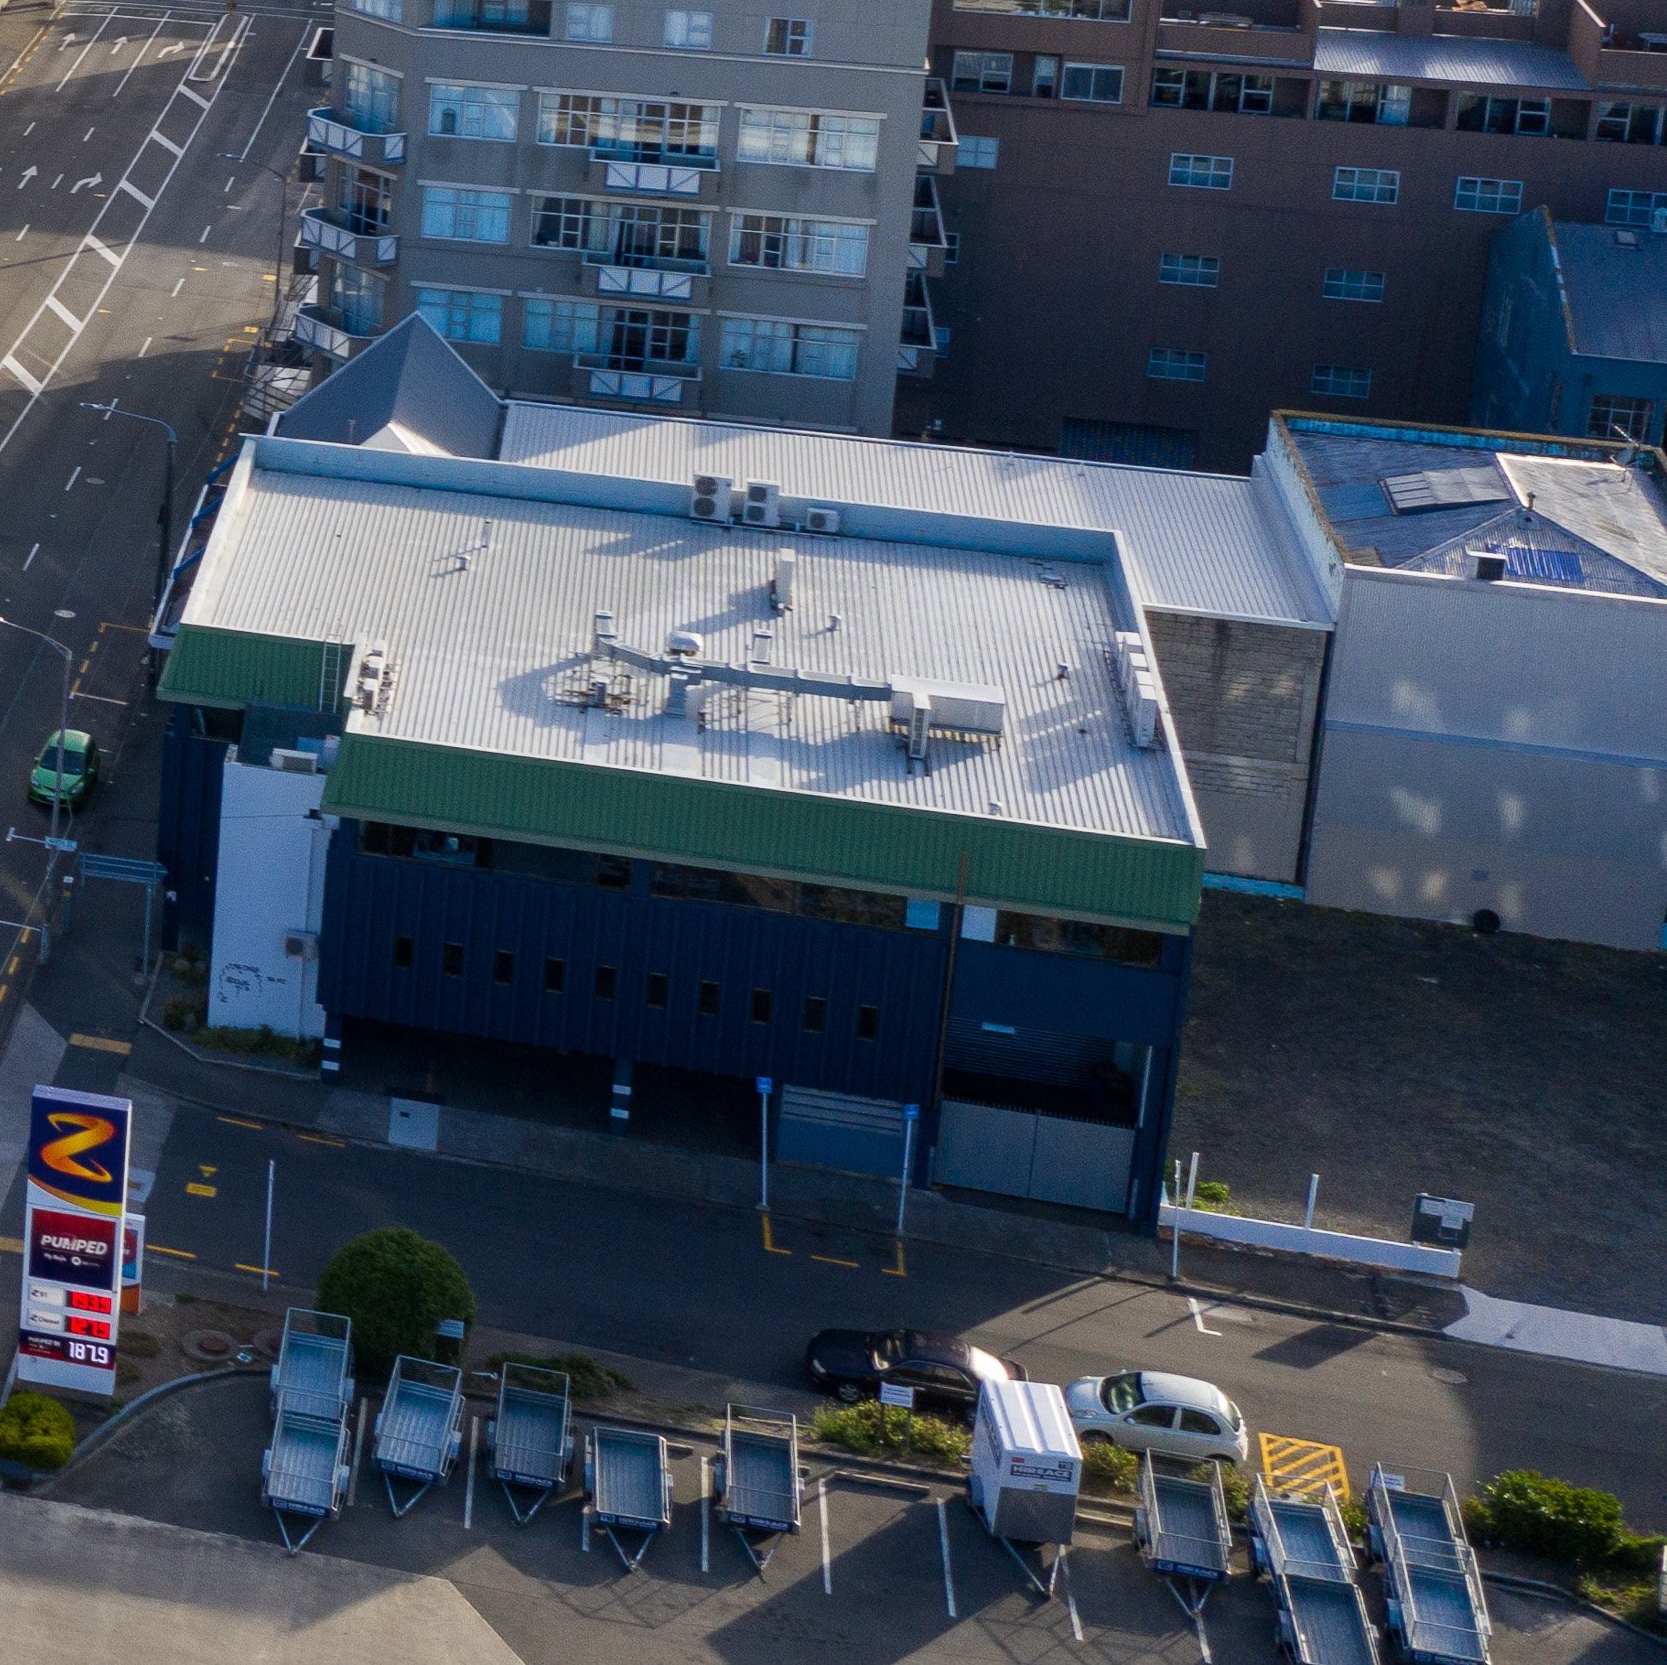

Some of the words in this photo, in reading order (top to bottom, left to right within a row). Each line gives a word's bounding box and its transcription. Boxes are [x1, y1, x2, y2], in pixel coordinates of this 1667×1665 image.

[40, 1112, 115, 1183] Z
[40, 1235, 108, 1256] PUMPED
[38, 1316, 60, 1326] Diesel
